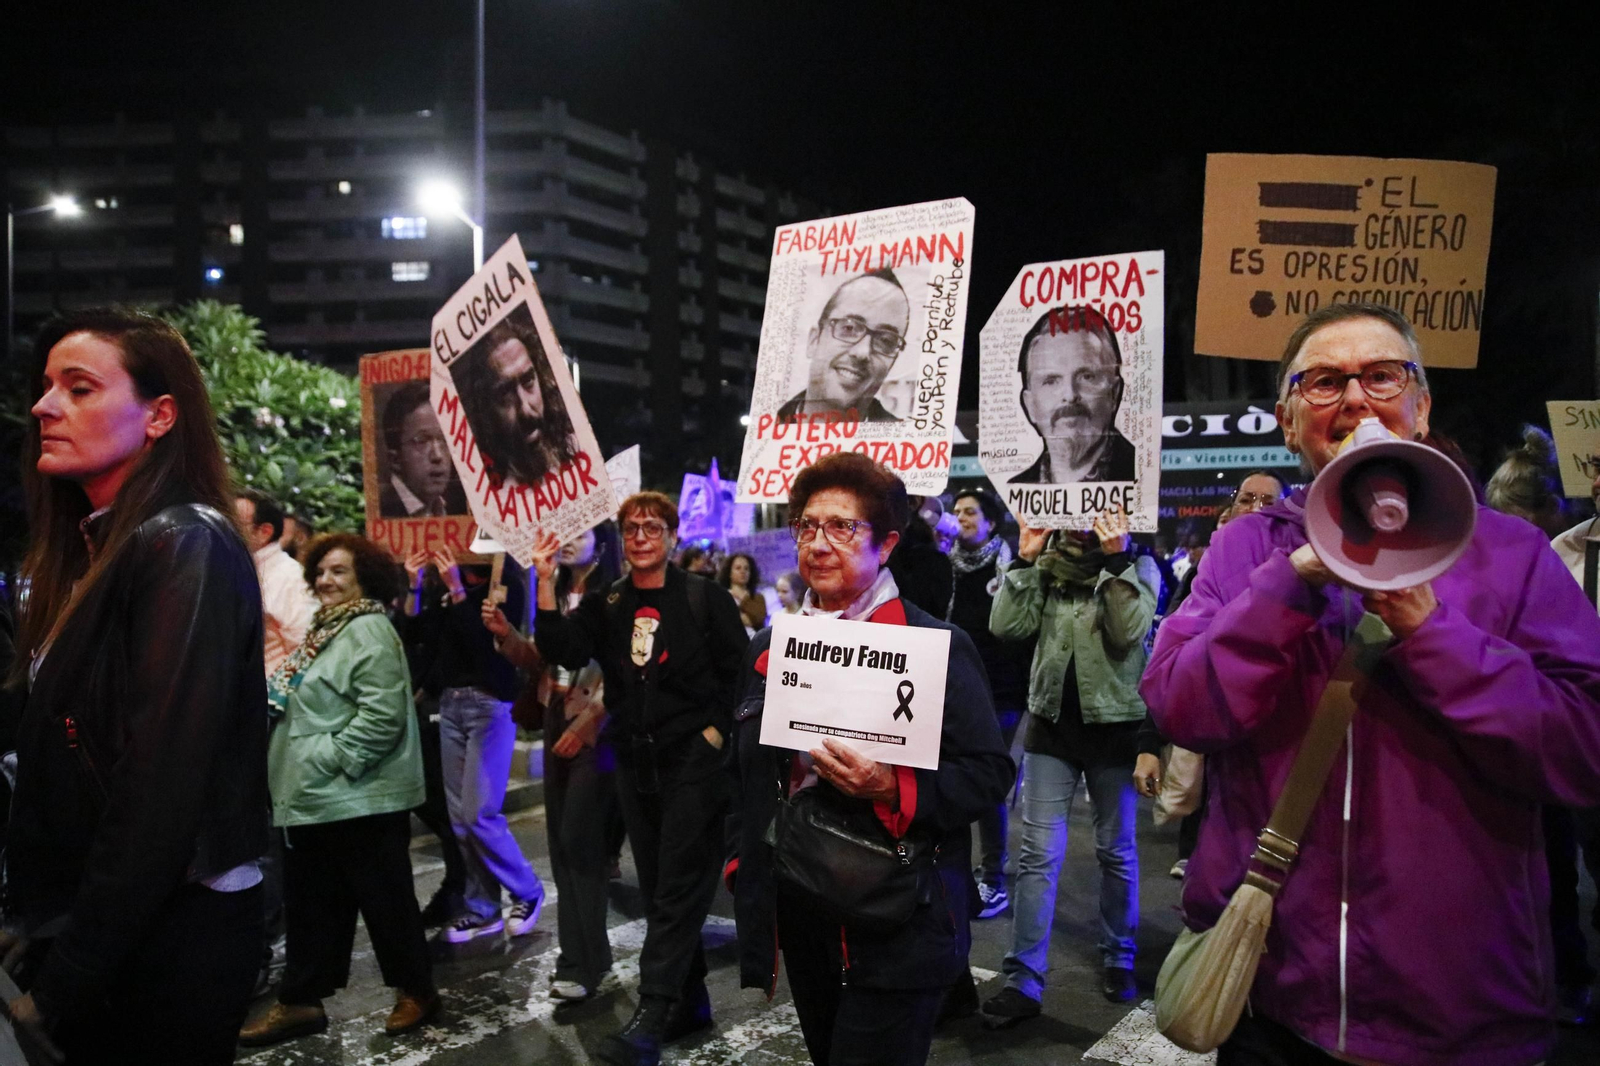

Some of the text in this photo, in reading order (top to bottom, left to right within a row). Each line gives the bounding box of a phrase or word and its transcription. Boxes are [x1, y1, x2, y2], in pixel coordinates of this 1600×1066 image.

[1381, 176, 1439, 209] EL
[776, 221, 857, 256] FABIAN
[1365, 209, 1467, 251] GÉNERO
[820, 231, 964, 277] THYLMANN
[1229, 248, 1428, 287] ES OPRESIÓN,
[1020, 258, 1159, 308] COMPRA-
[434, 328, 459, 364] EL
[456, 261, 525, 340] CIGALA
[1050, 297, 1142, 337] NIÑOS
[1285, 290, 1320, 316] NO
[914, 274, 945, 430] dueño Pornhub
[931, 257, 964, 431] youPorn y Redtube
[757, 407, 859, 442] PUTERO
[438, 387, 598, 527] MALTRATADOR
[980, 446, 1018, 459] músico
[1194, 452, 1255, 464] Vientres
[1261, 452, 1278, 461] de
[1008, 487, 1073, 515] MIGUEL
[784, 637, 909, 674] Audrey Fang,
[782, 671, 812, 689] 39 años
[793, 722, 818, 732] asesinada
[819, 727, 827, 735] por
[835, 729, 866, 740] compatriota
[867, 733, 878, 742] Ong
[879, 735, 903, 744] Mitchell
